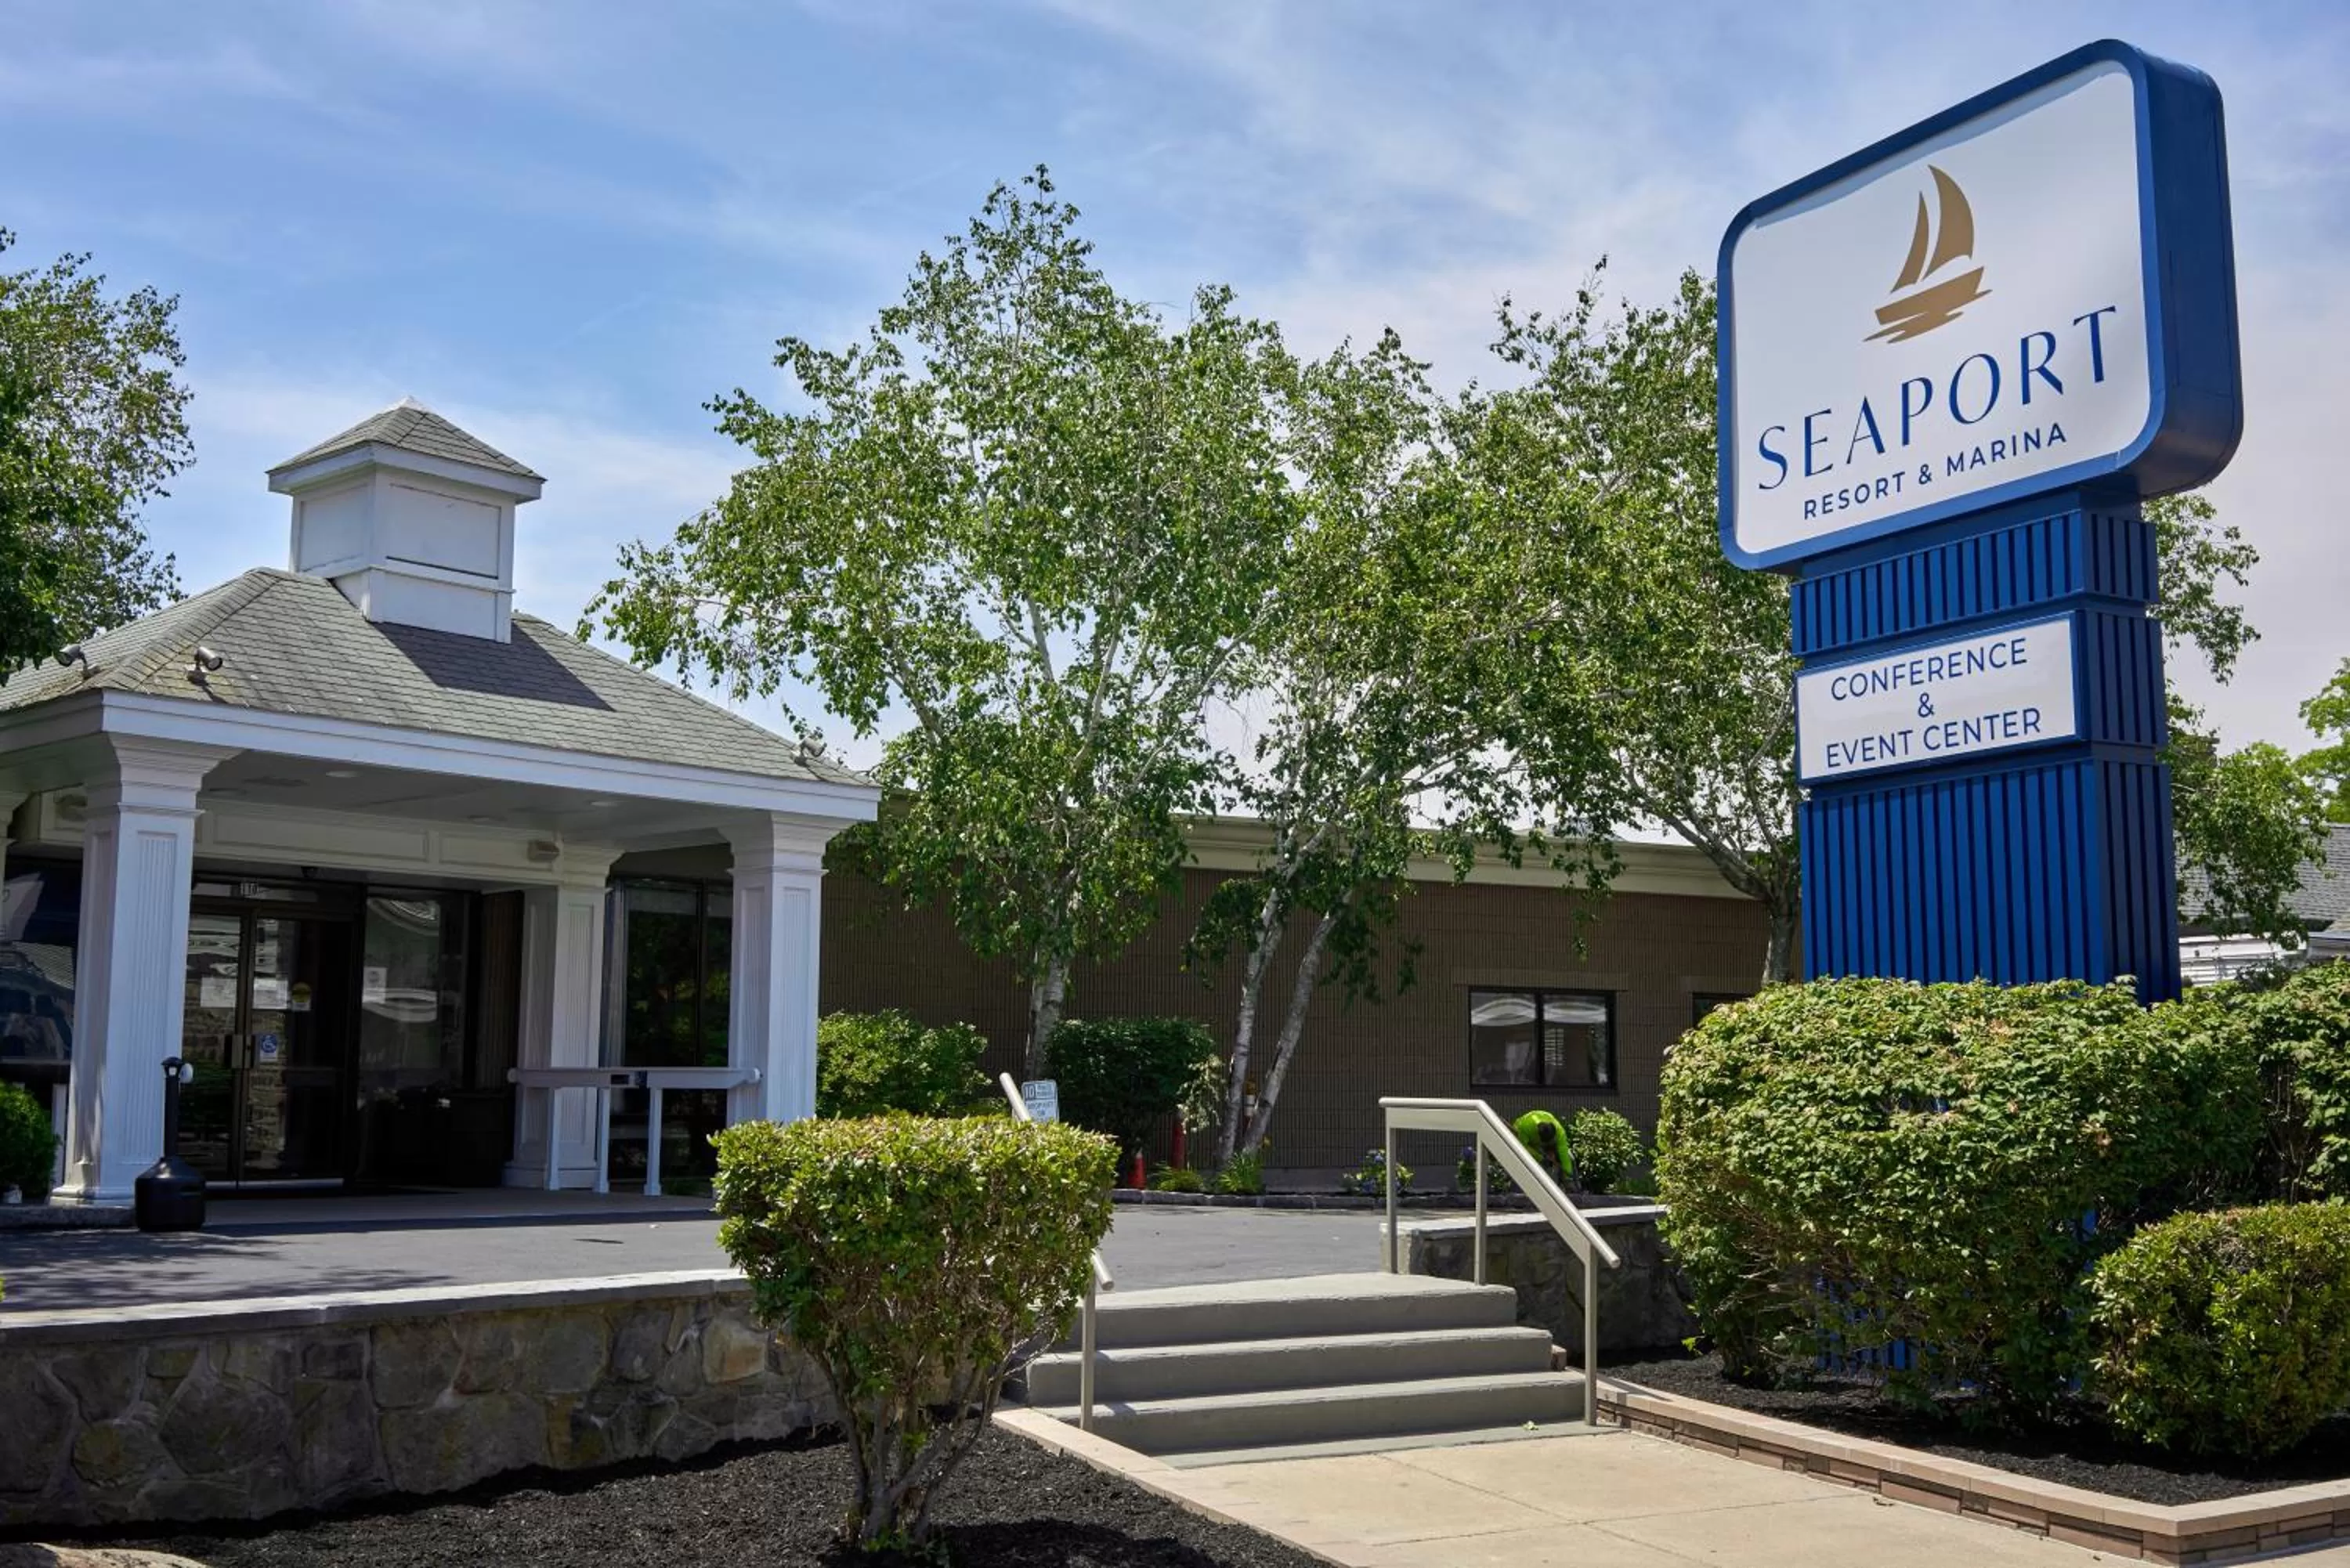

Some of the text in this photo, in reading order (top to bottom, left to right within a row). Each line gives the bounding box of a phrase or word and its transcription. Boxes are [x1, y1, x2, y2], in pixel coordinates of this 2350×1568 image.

[1758, 305, 2117, 490] SEAPORT
[1803, 422, 2067, 520] RESORT & MARINA
[1831, 637, 2028, 701] CONFERENCE
[1917, 692, 1935, 718] &
[1826, 707, 2041, 768] EVENT CENTER
[1025, 1086, 1035, 1098] 10
